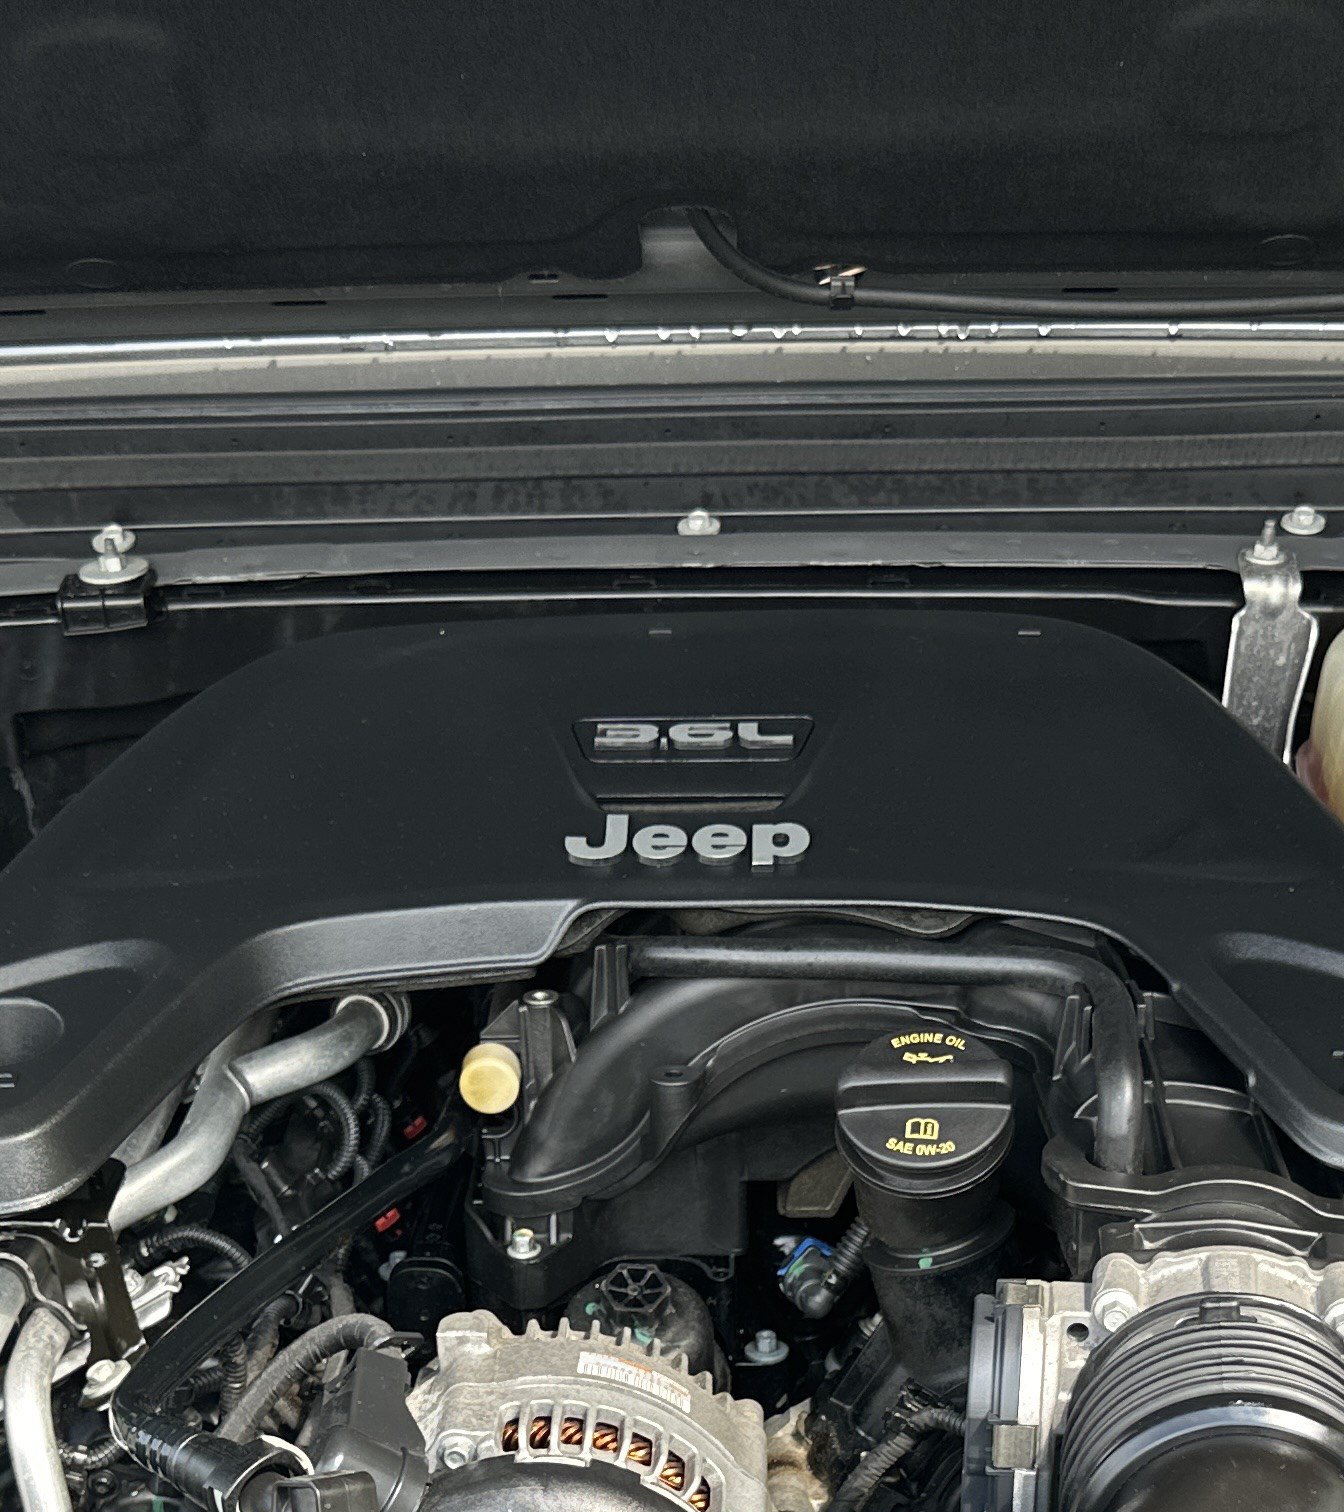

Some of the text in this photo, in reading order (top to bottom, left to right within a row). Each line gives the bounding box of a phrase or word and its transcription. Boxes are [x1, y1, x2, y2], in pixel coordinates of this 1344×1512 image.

[593, 721, 794, 751] 3.6L
[564, 813, 811, 867] Jeep
[890, 1032, 967, 1051] ENGINE OIL
[885, 1138, 956, 1156] SAE 0W-20
